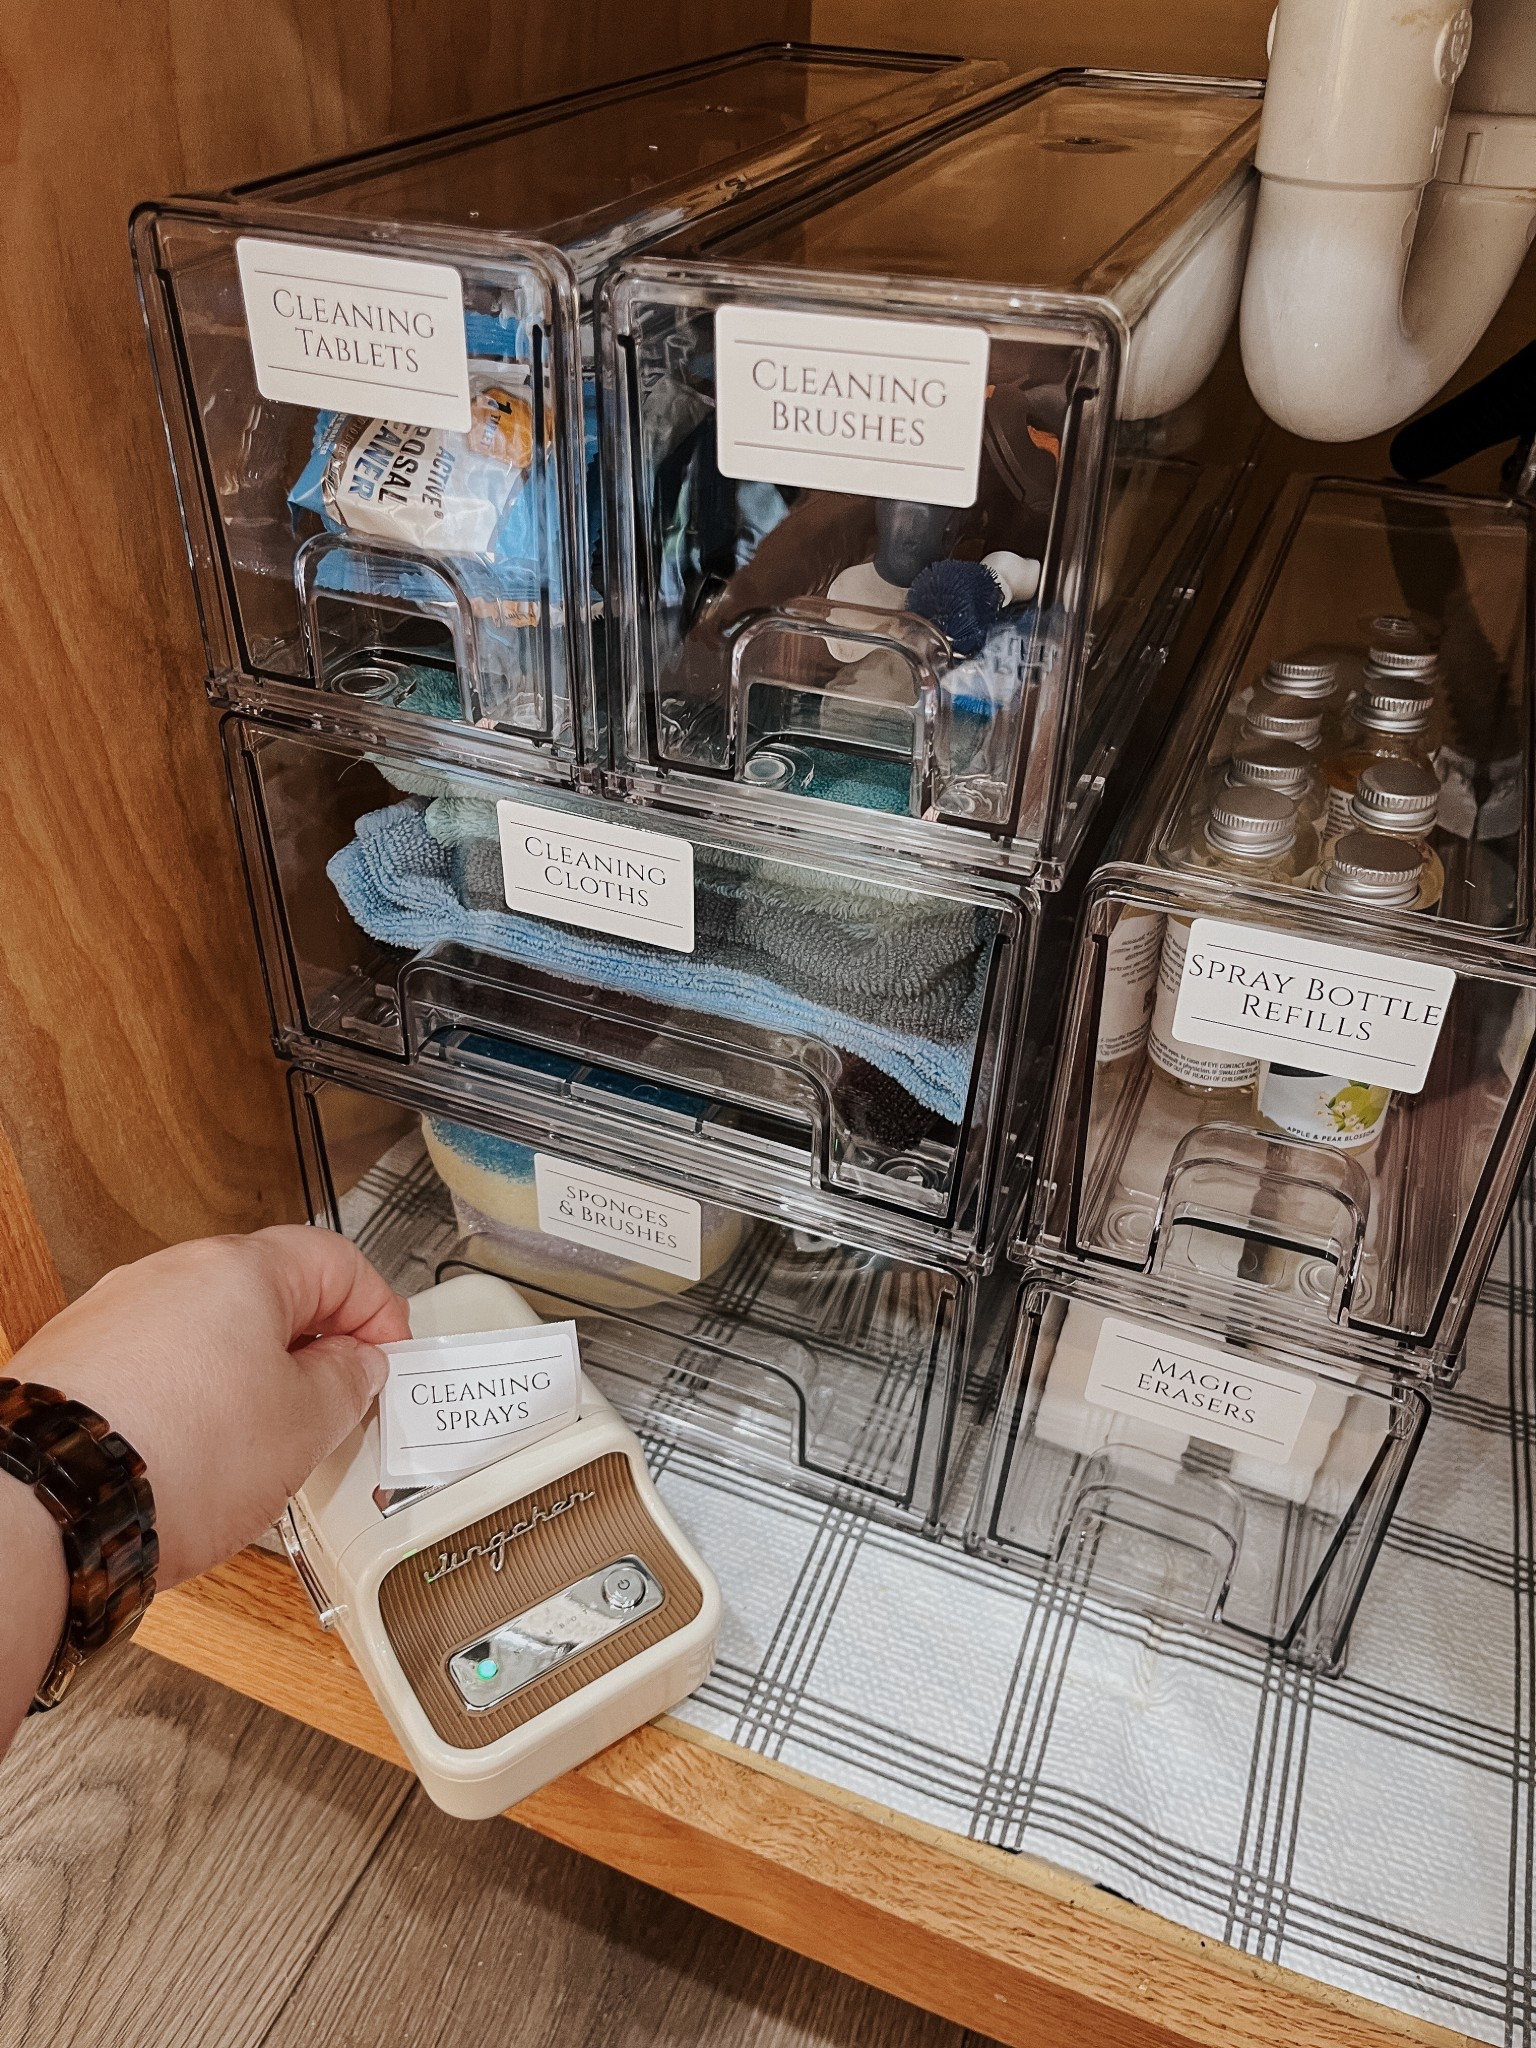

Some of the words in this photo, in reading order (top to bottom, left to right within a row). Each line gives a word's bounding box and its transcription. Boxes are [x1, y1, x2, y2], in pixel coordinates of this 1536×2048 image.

[273, 289, 434, 338] CLEANING
[295, 327, 419, 373] TABLETS
[752, 359, 948, 408] CLEANING
[772, 401, 925, 447] BRUSHES
[378, 426, 432, 506] POSAL
[525, 836, 666, 885] CLEANING
[544, 866, 649, 907] CLOTHS
[1188, 954, 1296, 994] SPRAY
[1306, 978, 1443, 1026] BOTTLE
[1241, 993, 1372, 1041] REFILLS
[1192, 1072, 1212, 1081] REACH
[1287, 1126, 1311, 1139] APPLE
[559, 1200, 575, 1217] &
[582, 1206, 677, 1248] BRUSHES
[567, 1185, 668, 1228] SPONGES
[411, 1371, 551, 1406] CLEANING
[1137, 1372, 1256, 1424] ERASERS
[1152, 1357, 1253, 1401] MAGIC
[436, 1401, 529, 1431] SPRAYS
